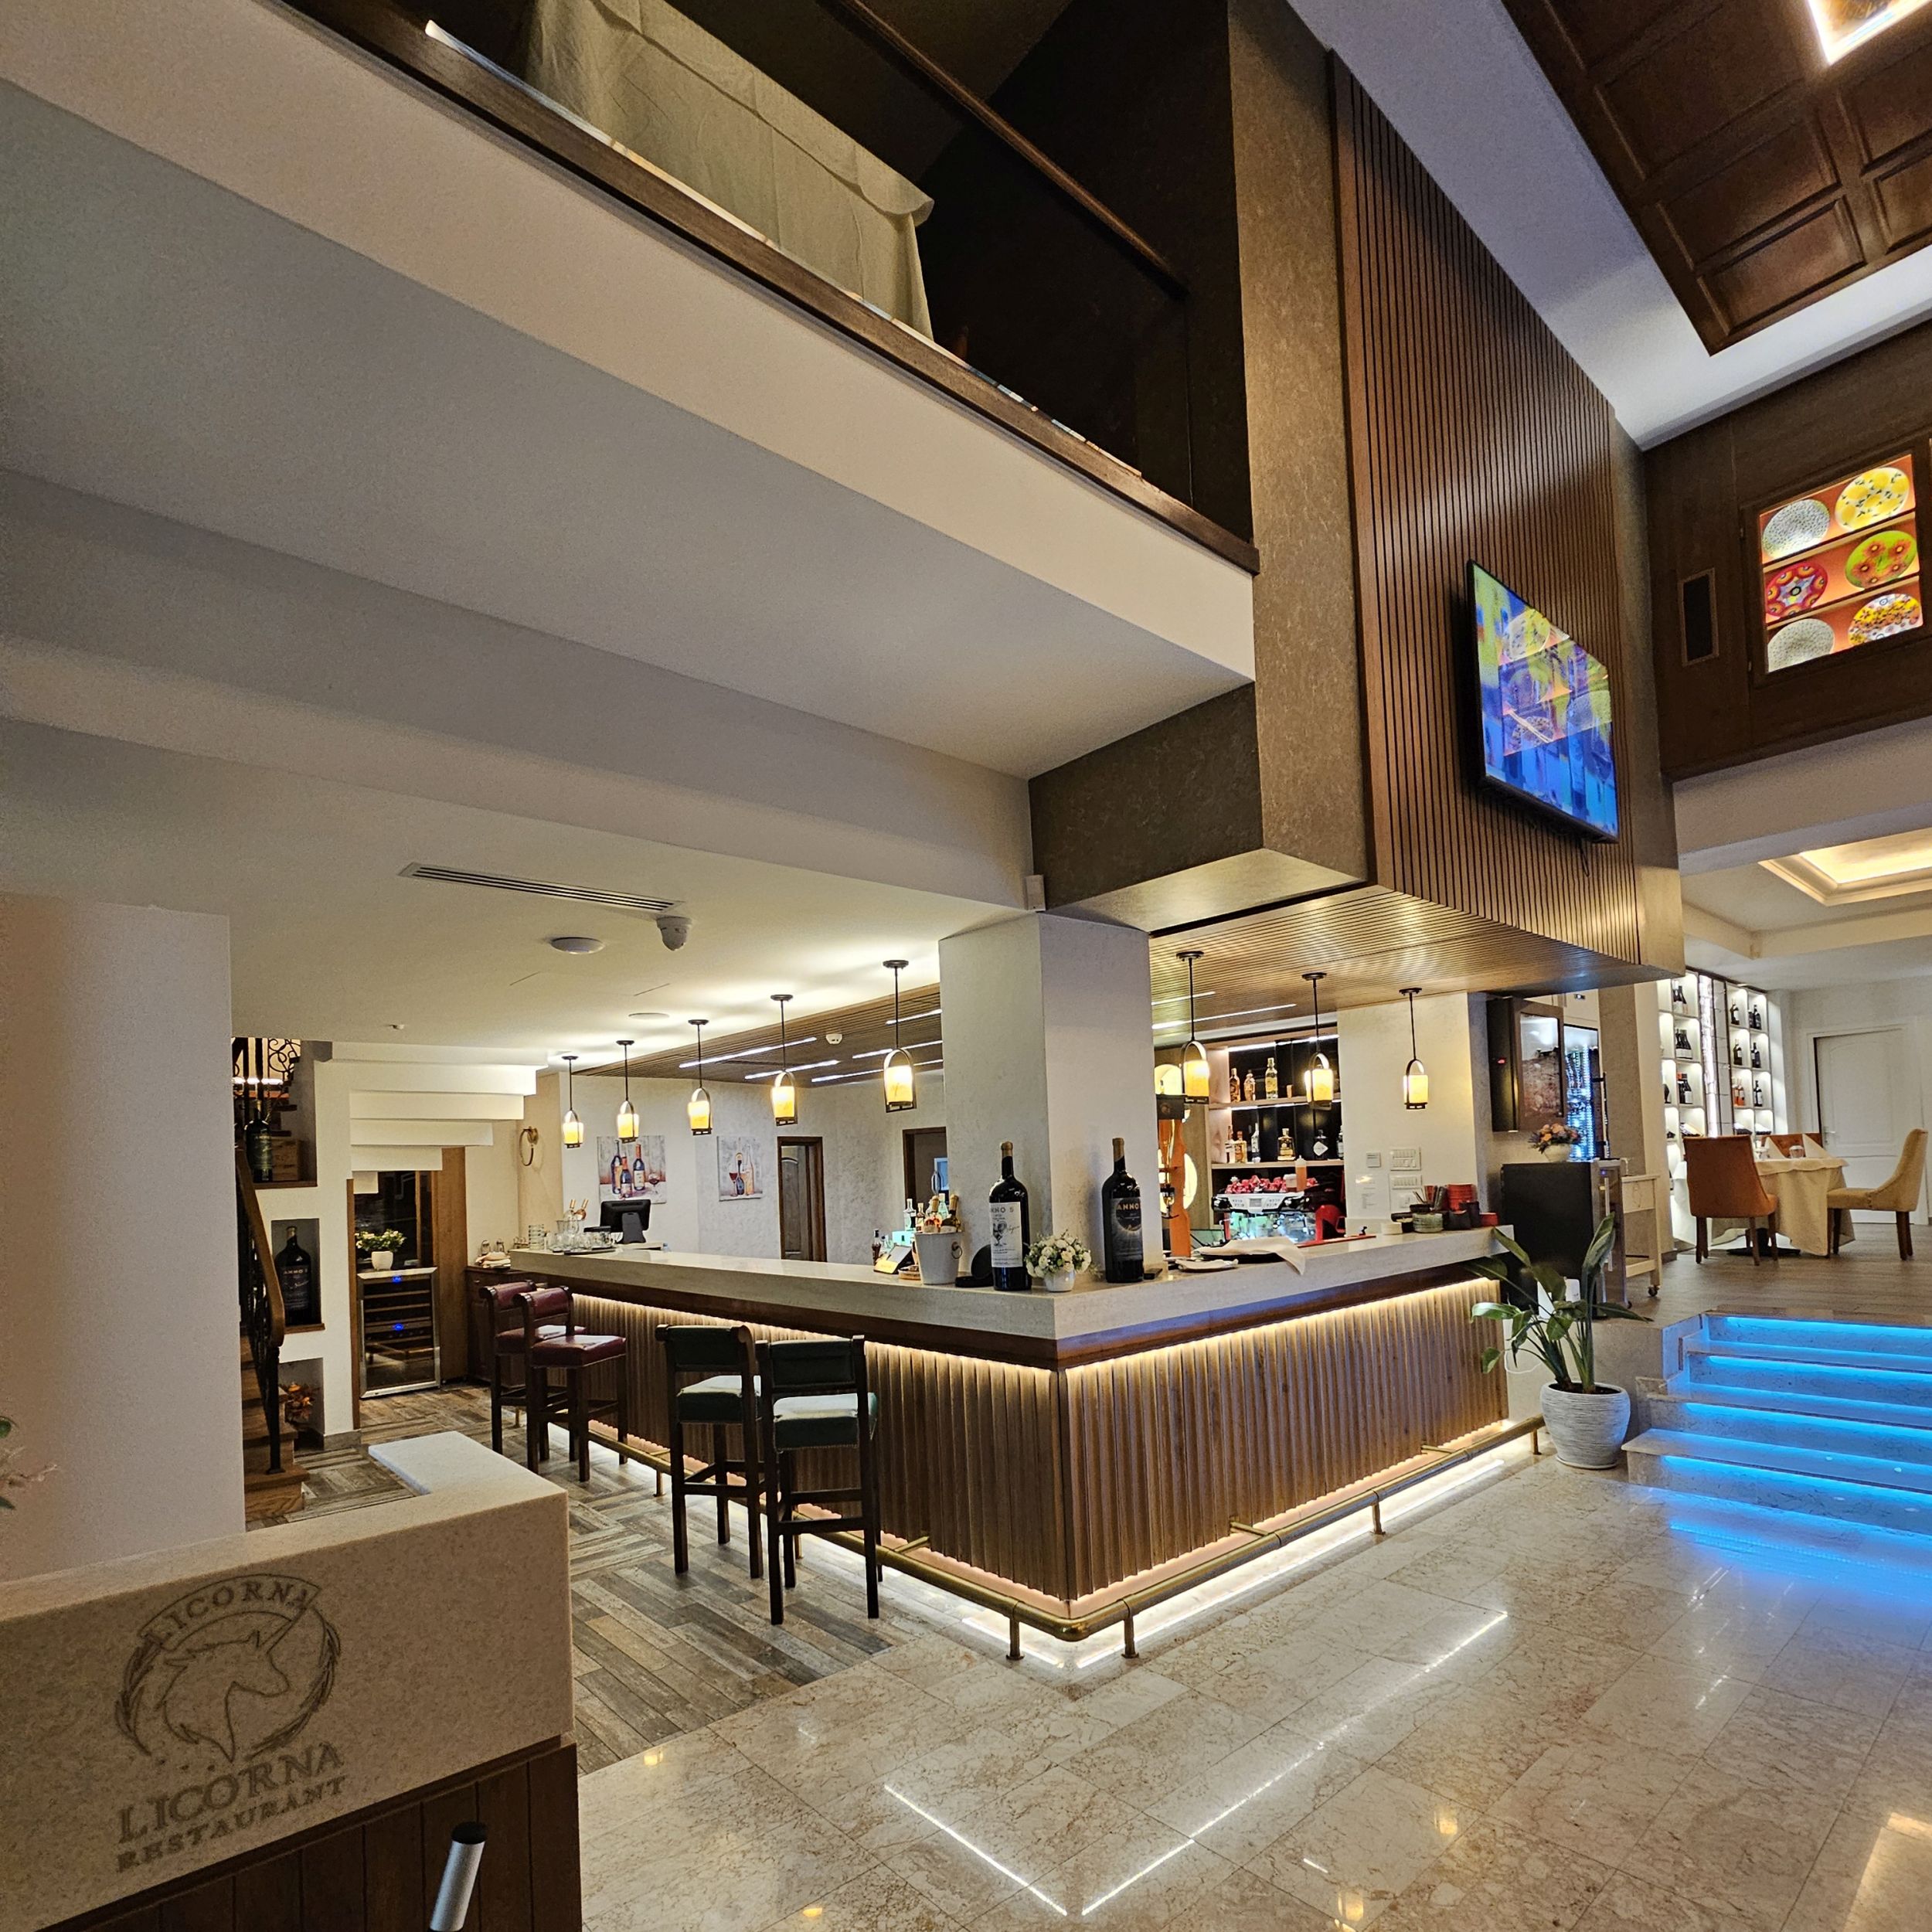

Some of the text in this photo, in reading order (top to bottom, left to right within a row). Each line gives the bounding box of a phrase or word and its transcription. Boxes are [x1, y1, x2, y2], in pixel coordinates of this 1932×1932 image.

[142, 1580, 311, 1646] LICORNA
[117, 1775, 346, 1873] RESTAURANT
[118, 1742, 344, 1844] LICORNA
